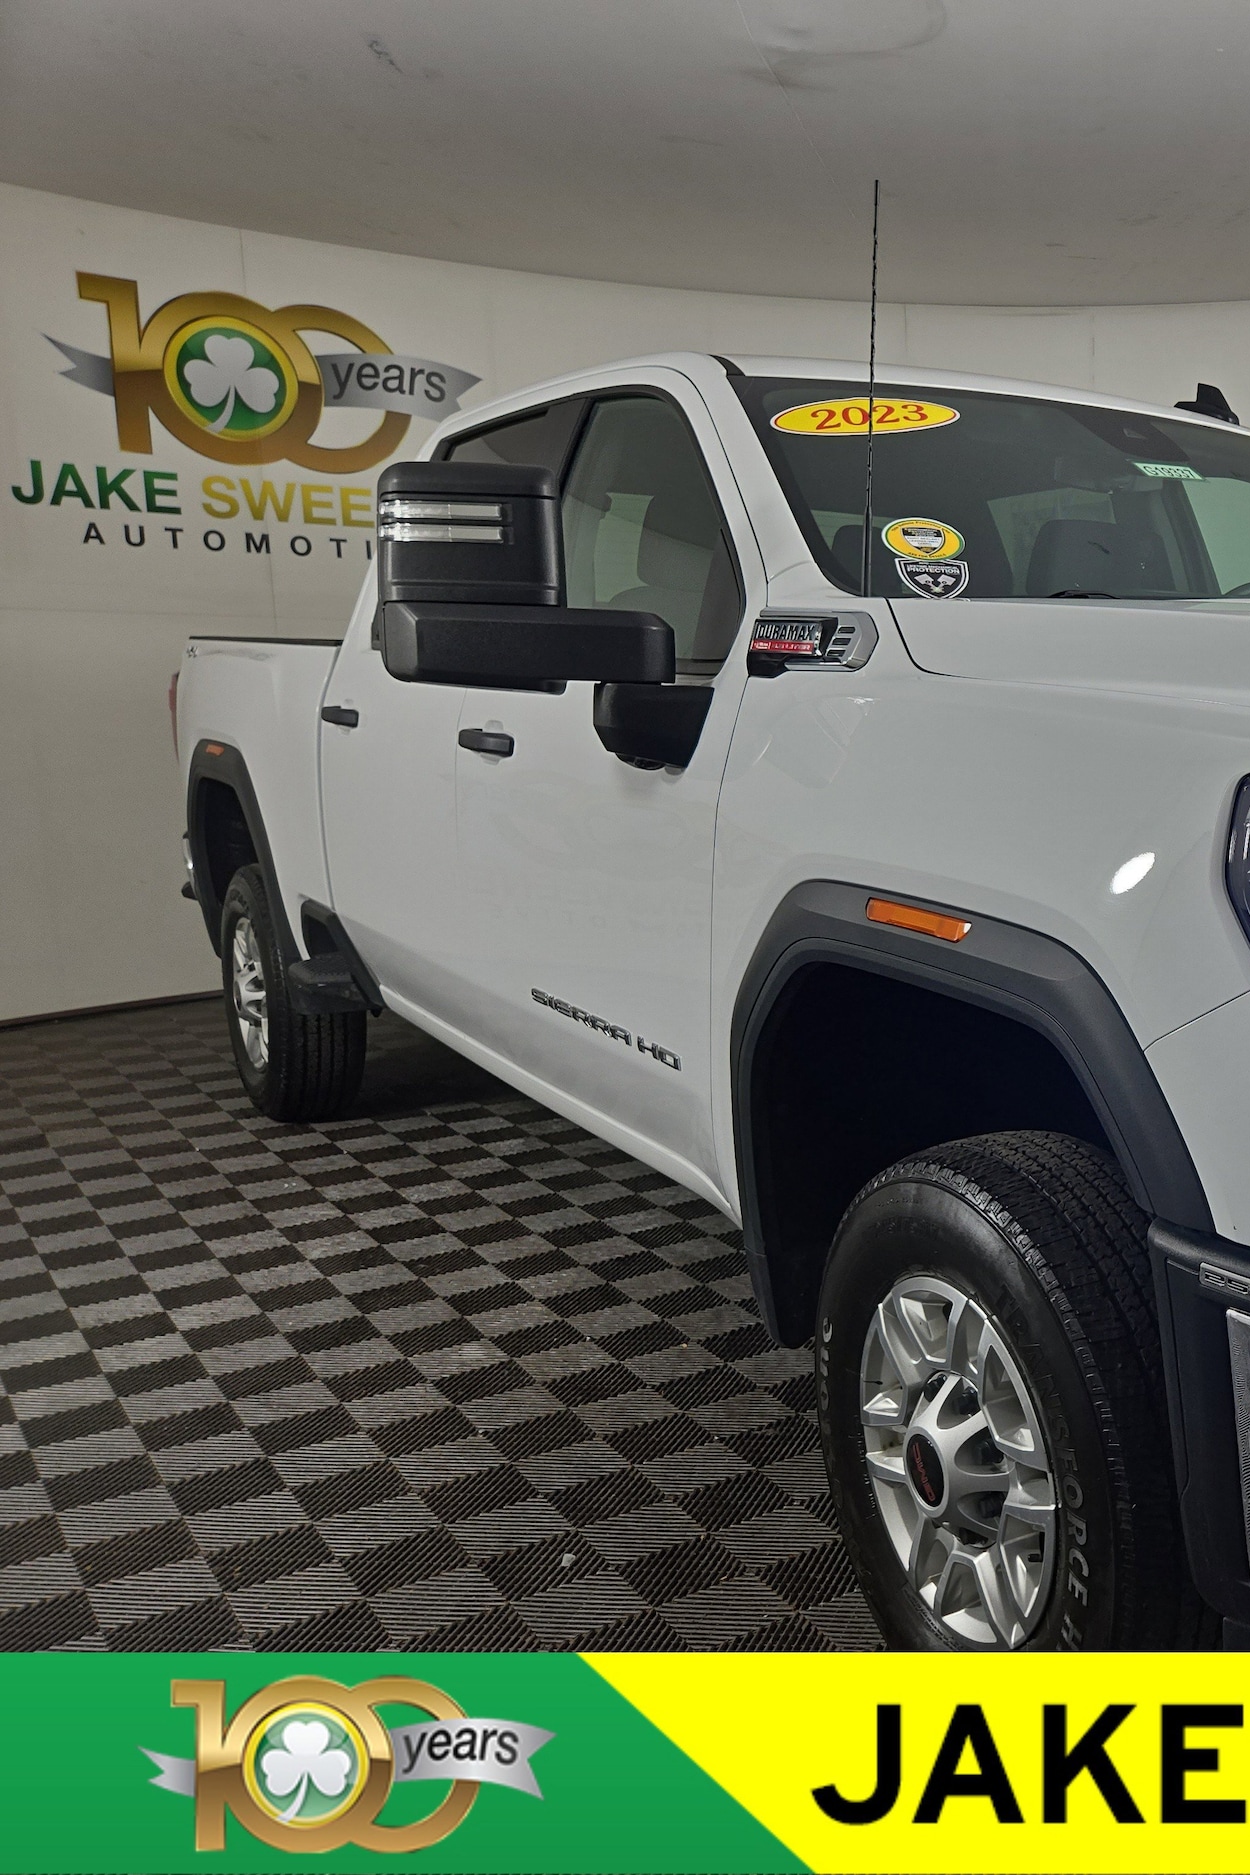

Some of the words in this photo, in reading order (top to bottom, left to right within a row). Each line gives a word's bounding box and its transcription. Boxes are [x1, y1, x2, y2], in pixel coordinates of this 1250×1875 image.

[76, 271, 412, 474] 100
[331, 358, 447, 402] years
[810, 403, 929, 431] 2023
[11, 459, 182, 515] JAKE
[201, 476, 376, 529] SWEE
[83, 521, 372, 561] AUTOMOTI
[754, 623, 815, 641] DURAMAX
[531, 987, 633, 1047] SIERRA
[637, 1035, 682, 1072] HD
[911, 1441, 937, 1502] GMC
